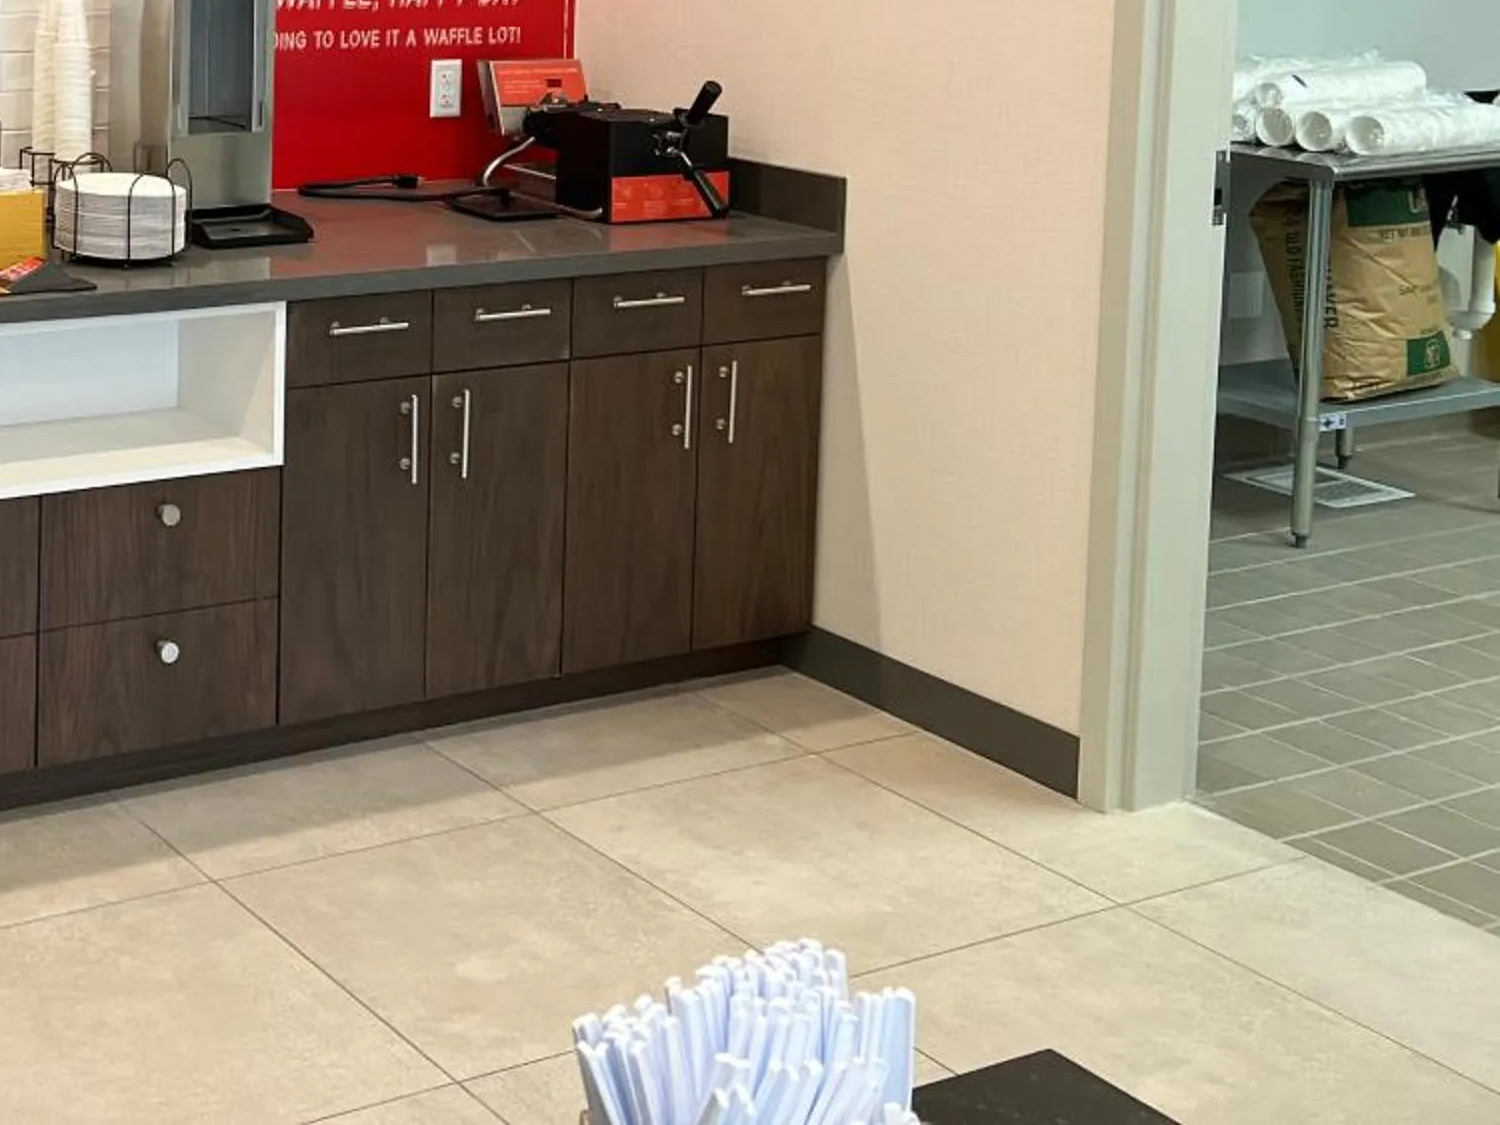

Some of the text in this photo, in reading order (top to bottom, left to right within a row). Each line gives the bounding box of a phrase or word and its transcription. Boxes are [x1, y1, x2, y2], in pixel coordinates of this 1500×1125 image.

[314, 30, 335, 49] TO
[340, 29, 380, 49] LOVE
[385, 28, 401, 47] IT
[405, 28, 417, 47] A
[423, 27, 483, 46] WAFFLE
[488, 26, 521, 44] LOT!
